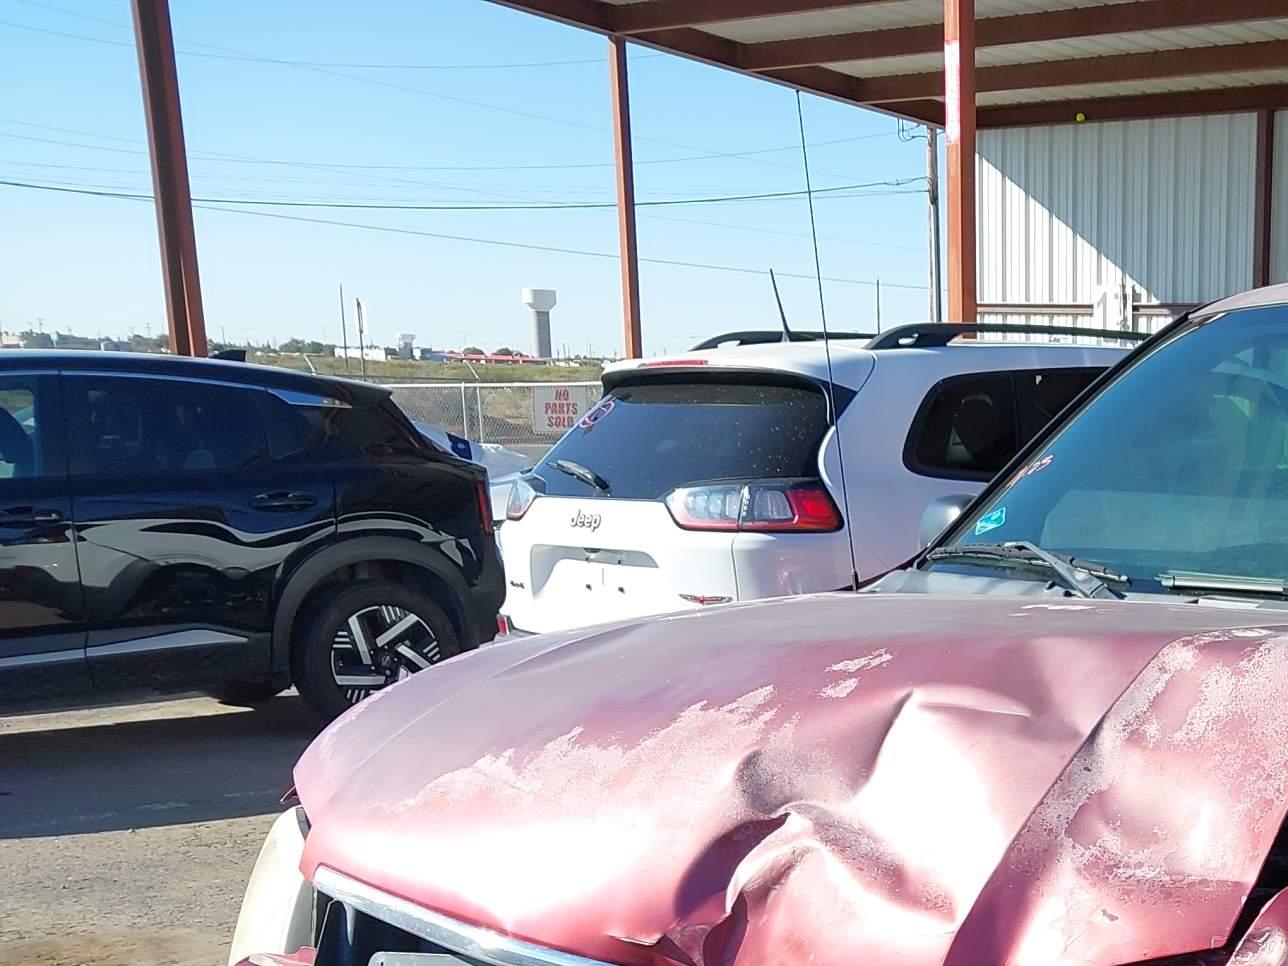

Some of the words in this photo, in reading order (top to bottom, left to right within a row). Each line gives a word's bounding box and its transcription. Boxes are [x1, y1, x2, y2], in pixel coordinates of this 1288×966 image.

[554, 389, 569, 401] NO
[544, 402, 577, 415] PARTS
[547, 416, 574, 428] SOLD
[570, 509, 602, 532] Jeep
